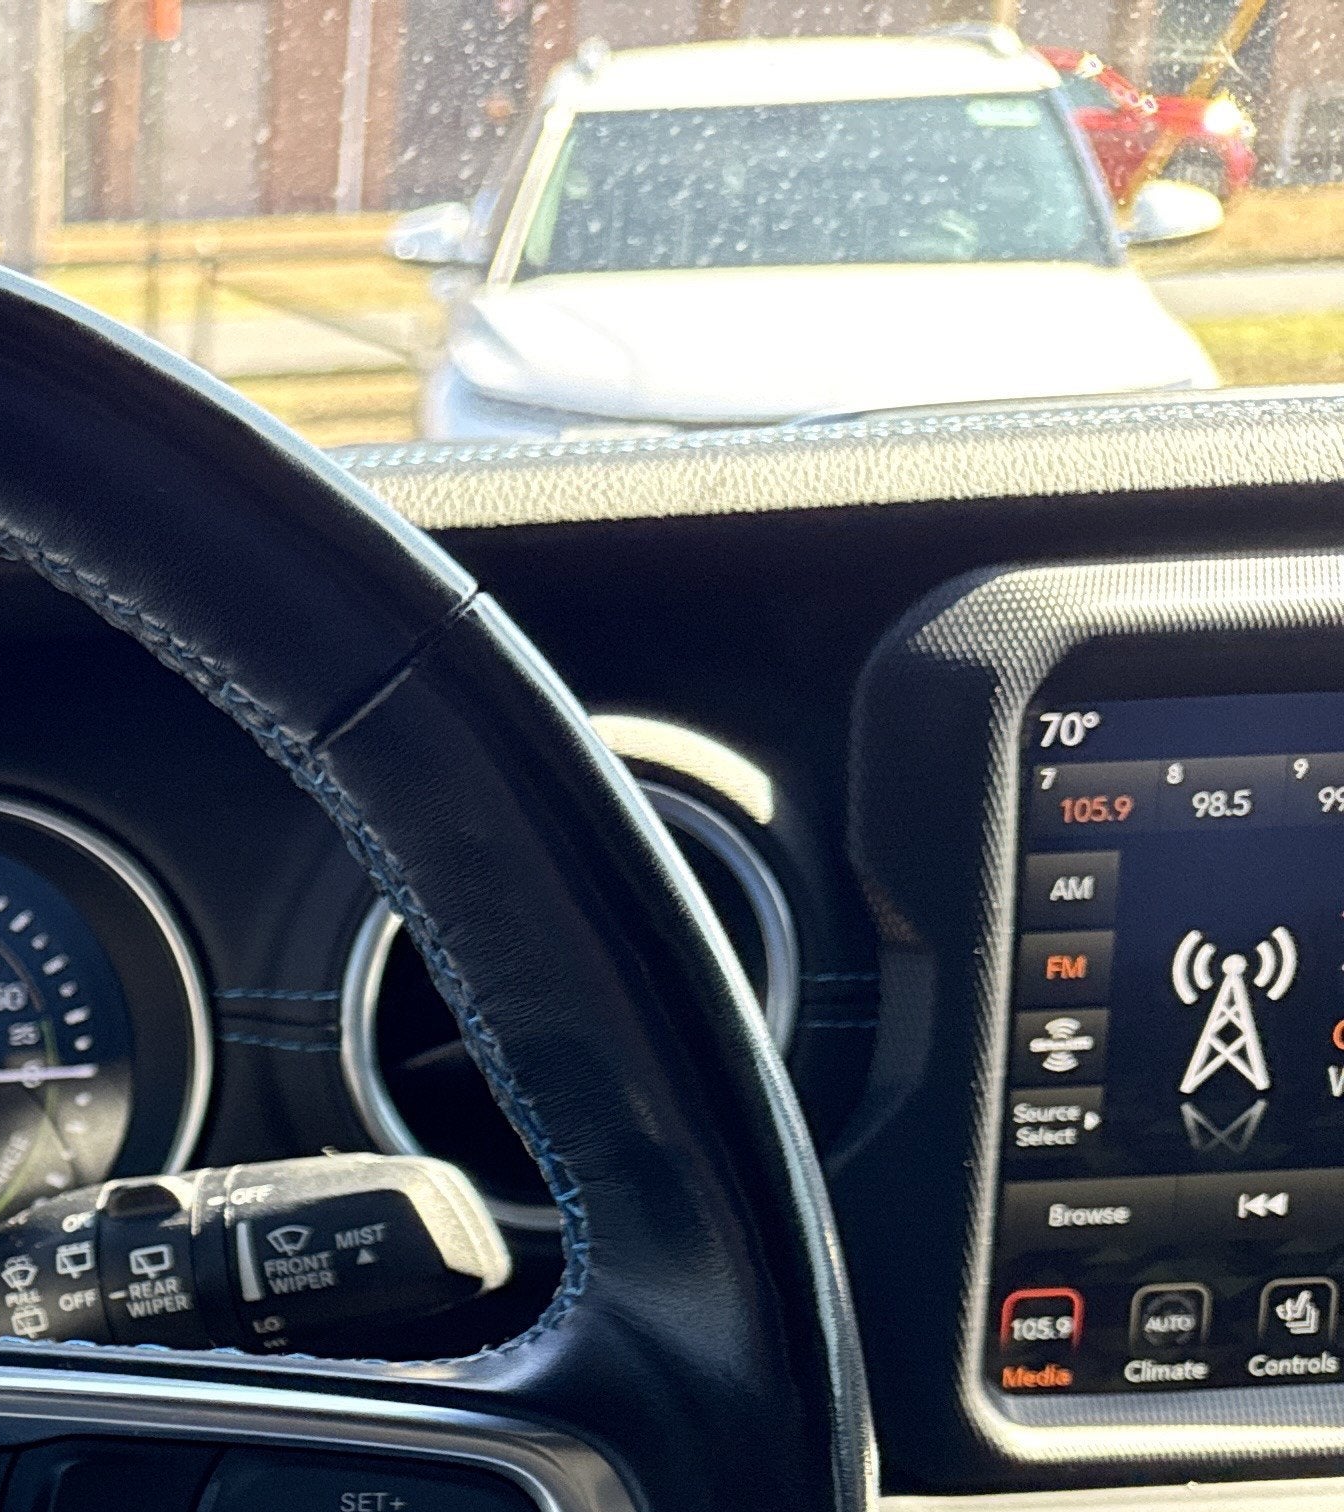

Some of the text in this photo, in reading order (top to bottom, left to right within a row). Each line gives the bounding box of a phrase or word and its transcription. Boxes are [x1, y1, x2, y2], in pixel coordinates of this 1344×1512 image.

[1040, 758, 1309, 789] 7 8 9
[1060, 795, 1134, 823] 105.9
[1192, 789, 1252, 817] 98.5
[1050, 875, 1094, 901] AM
[1045, 955, 1087, 980] FM
[1013, 1103, 1082, 1125] Source
[1015, 1127, 1078, 1147] Select
[231, 1184, 271, 1205] OFF
[1048, 1203, 1132, 1228] Browse
[335, 1222, 387, 1250] MIST
[263, 1250, 331, 1277] FRONT
[128, 1276, 181, 1300] REAR
[268, 1269, 335, 1295] WIPER
[59, 1288, 96, 1312] OFF
[126, 1293, 191, 1318] WIPER
[1144, 1314, 1196, 1334] AUTO
[1002, 1363, 1073, 1388] Media
[1124, 1359, 1210, 1384] Climate
[1247, 1351, 1341, 1378] Controls
